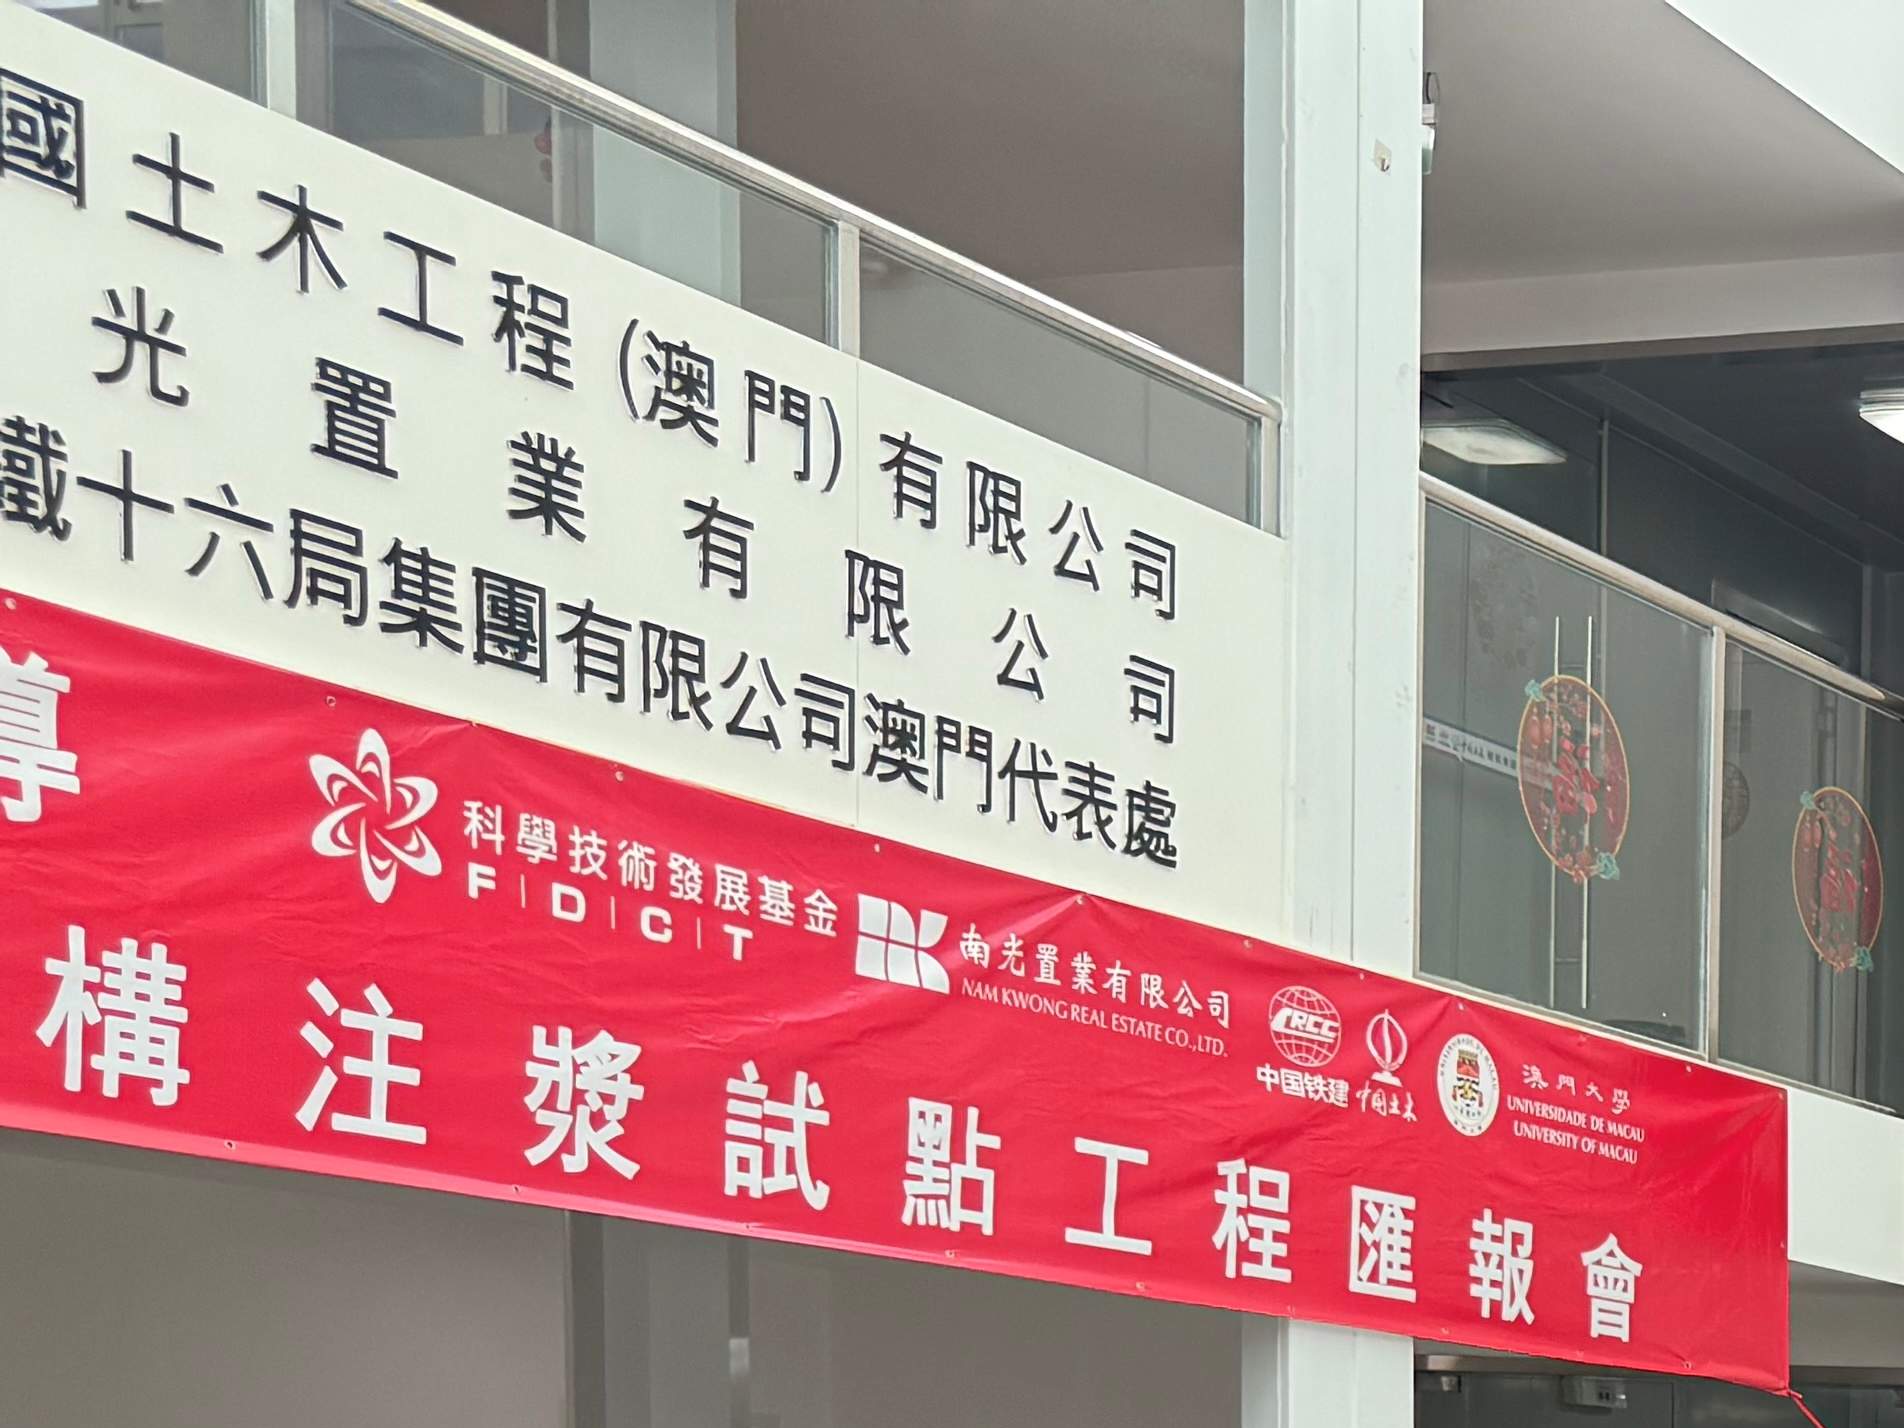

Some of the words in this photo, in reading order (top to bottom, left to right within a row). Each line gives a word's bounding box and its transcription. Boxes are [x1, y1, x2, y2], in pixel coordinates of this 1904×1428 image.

[464, 800, 839, 938] 科學技術發展基金
[960, 923, 1230, 1029] 南光置業有限公司
[962, 977, 998, 1003] NAM
[1002, 987, 1068, 1020] KWONG
[1071, 1004, 1107, 1029] REAL
[1112, 1013, 1162, 1042] ESTATE
[1270, 1007, 1339, 1044] CRCC
[1256, 1063, 1350, 1108] 中国铁建
[1522, 1063, 1632, 1115] 澳門大學
[35, 924, 1643, 1342] 構注漿試點工程匯報會
[1507, 1095, 1587, 1130] UNIVERSIDADE
[1590, 1115, 1605, 1133] DE
[1606, 1118, 1646, 1143] MACAU
[1513, 1120, 1579, 1151] UNIVERSITY
[1581, 1136, 1597, 1154] OF
[1599, 1142, 1639, 1165] MACAU
